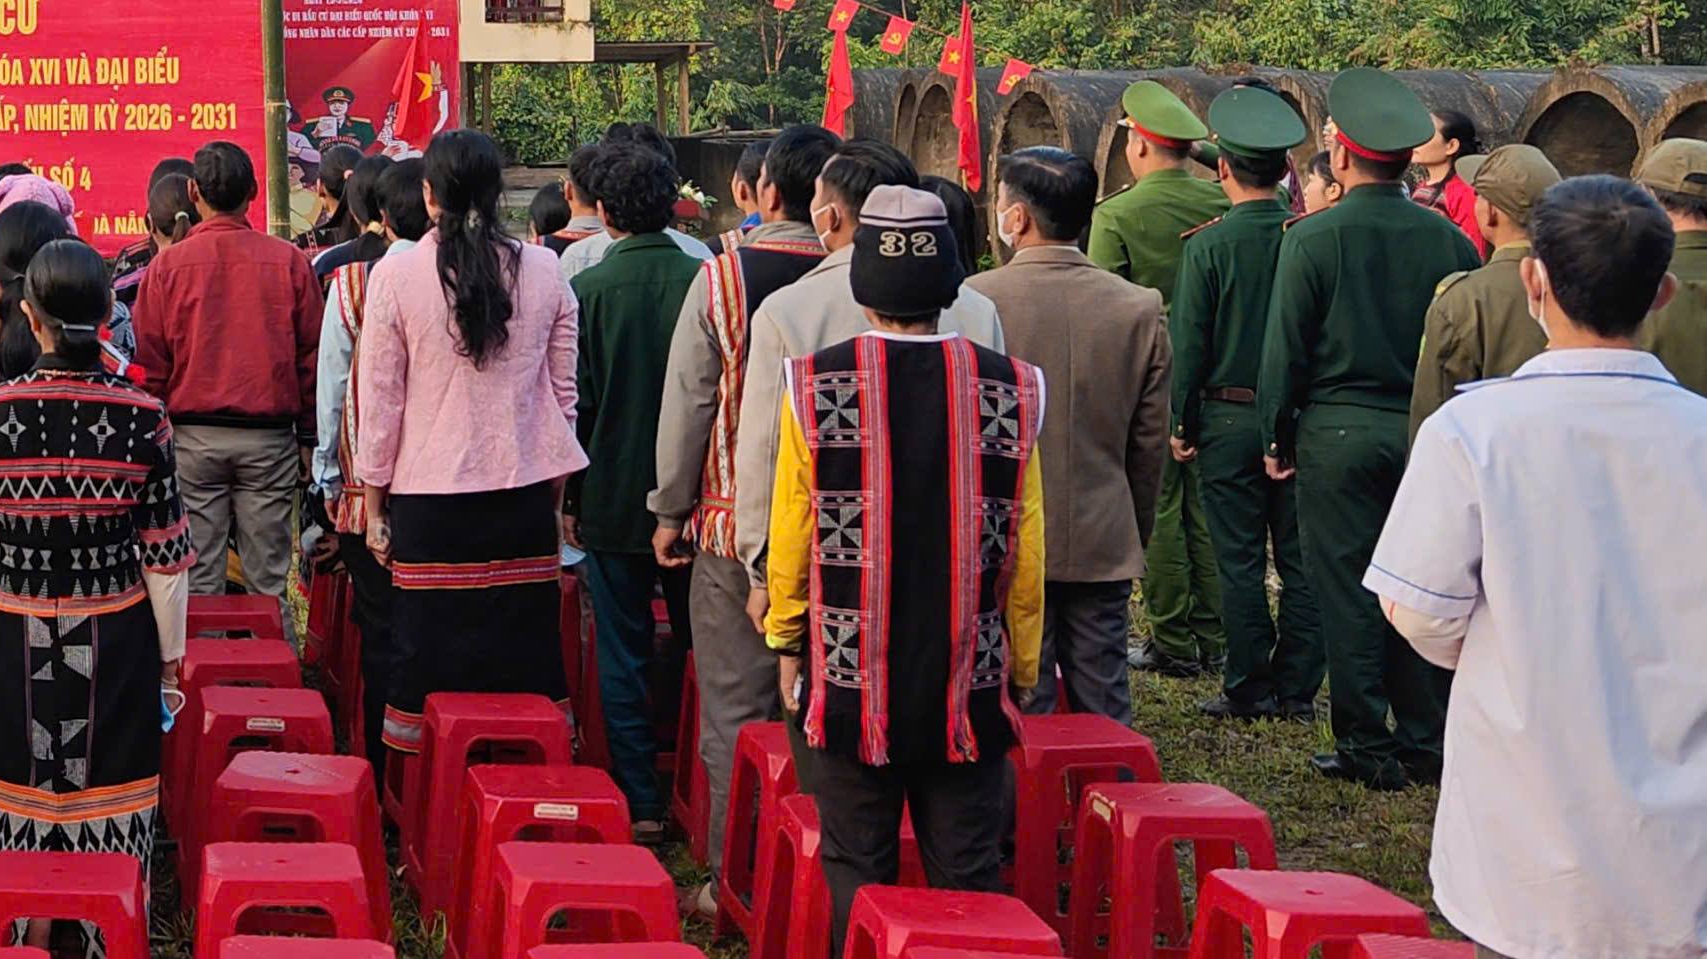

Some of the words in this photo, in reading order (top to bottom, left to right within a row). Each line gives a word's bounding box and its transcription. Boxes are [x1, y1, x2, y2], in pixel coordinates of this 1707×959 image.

[29, 57, 60, 85] XVI
[65, 52, 92, 85] VÀ
[96, 56, 129, 91] ĐẠI
[135, 46, 179, 85] BIỂU
[25, 98, 88, 137] NHIỆM
[94, 98, 119, 131] KỲ
[124, 103, 172, 131] 2026
[176, 114, 187, 123] -
[190, 103, 236, 131] 2031
[49, 157, 75, 191] SỐ
[79, 166, 93, 191] 4
[114, 210, 151, 235] NẴN
[879, 231, 938, 257] 32
